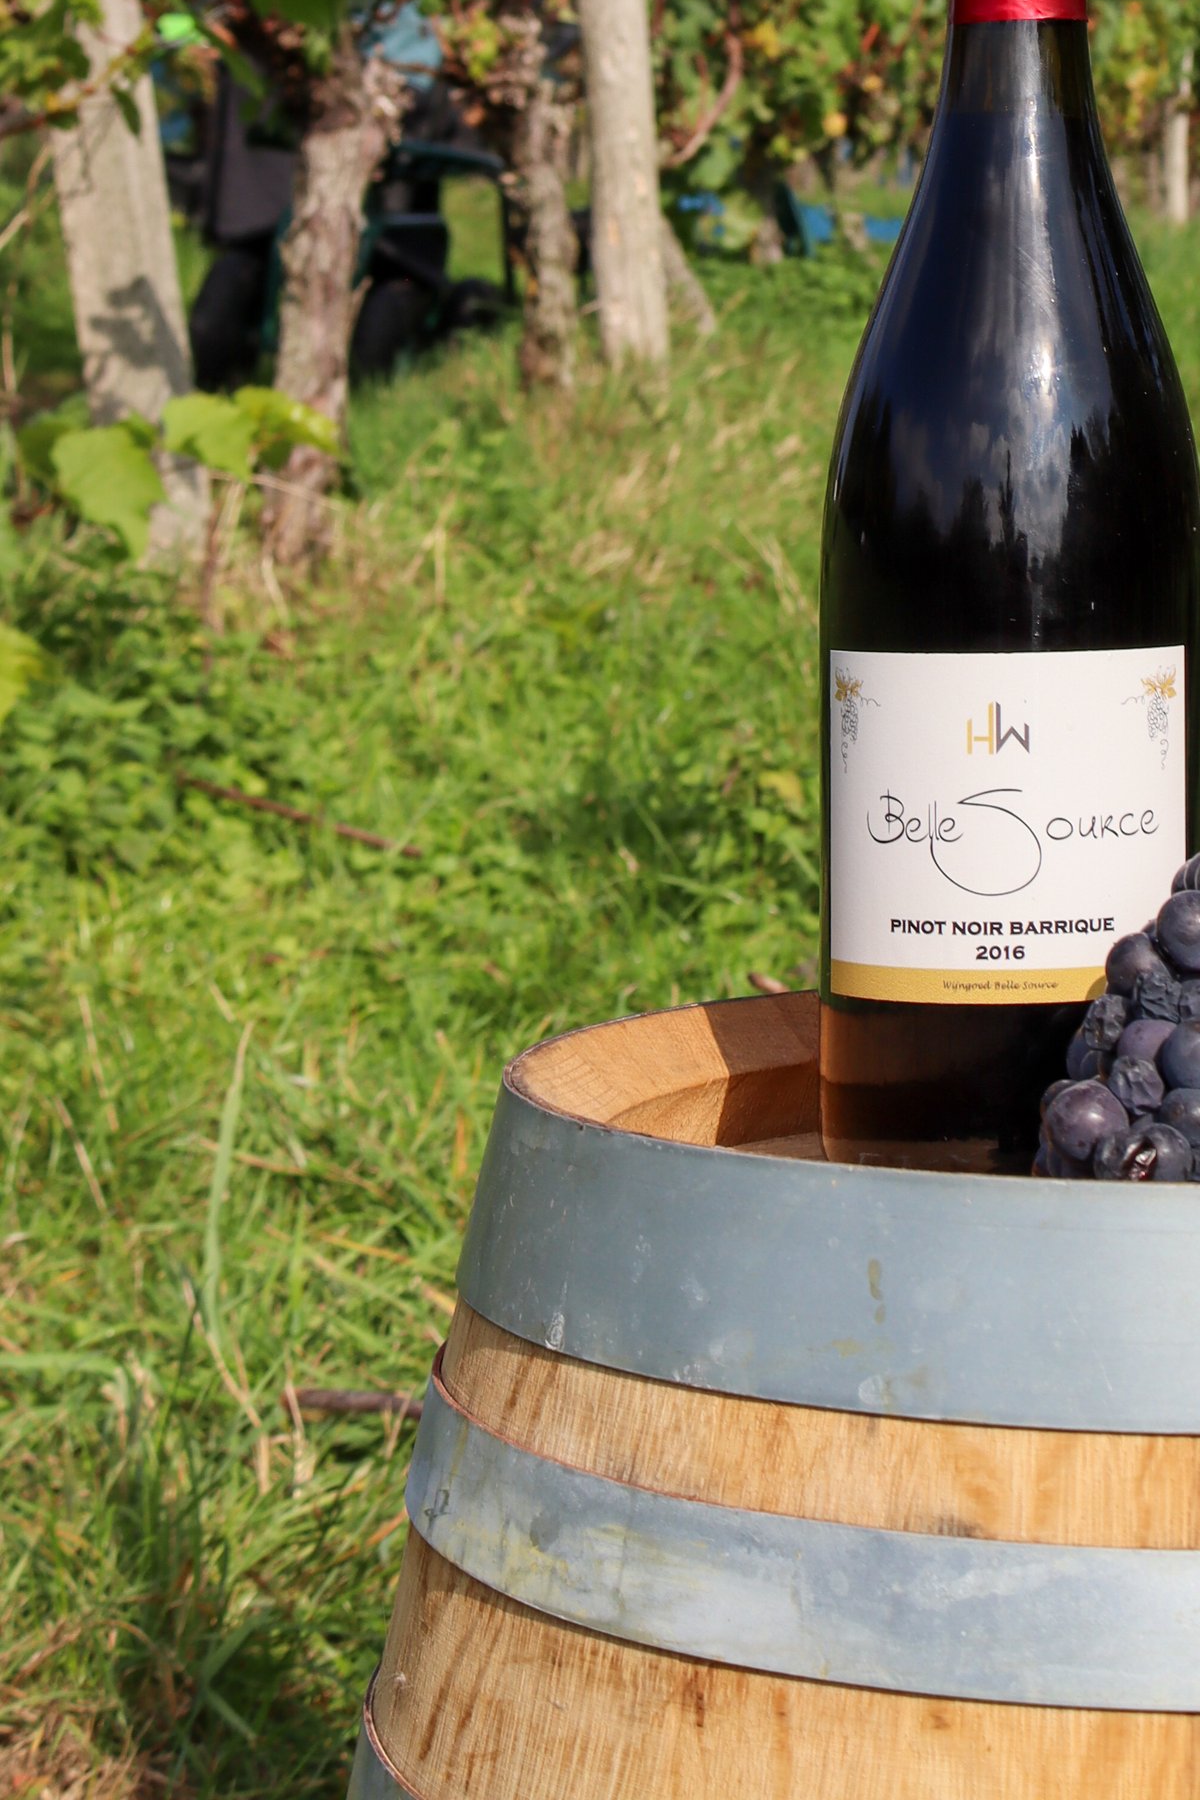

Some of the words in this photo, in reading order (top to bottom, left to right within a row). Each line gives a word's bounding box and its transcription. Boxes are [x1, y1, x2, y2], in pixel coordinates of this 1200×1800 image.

[867, 788, 964, 844] Belle
[930, 788, 1159, 897] Source
[890, 918, 947, 935] PINOT
[952, 920, 1003, 936] NOIR
[1009, 917, 1115, 936] BARRIQUE
[975, 945, 1026, 961] 2016
[994, 980, 1020, 990] Belle
[1023, 980, 1059, 991] Source
